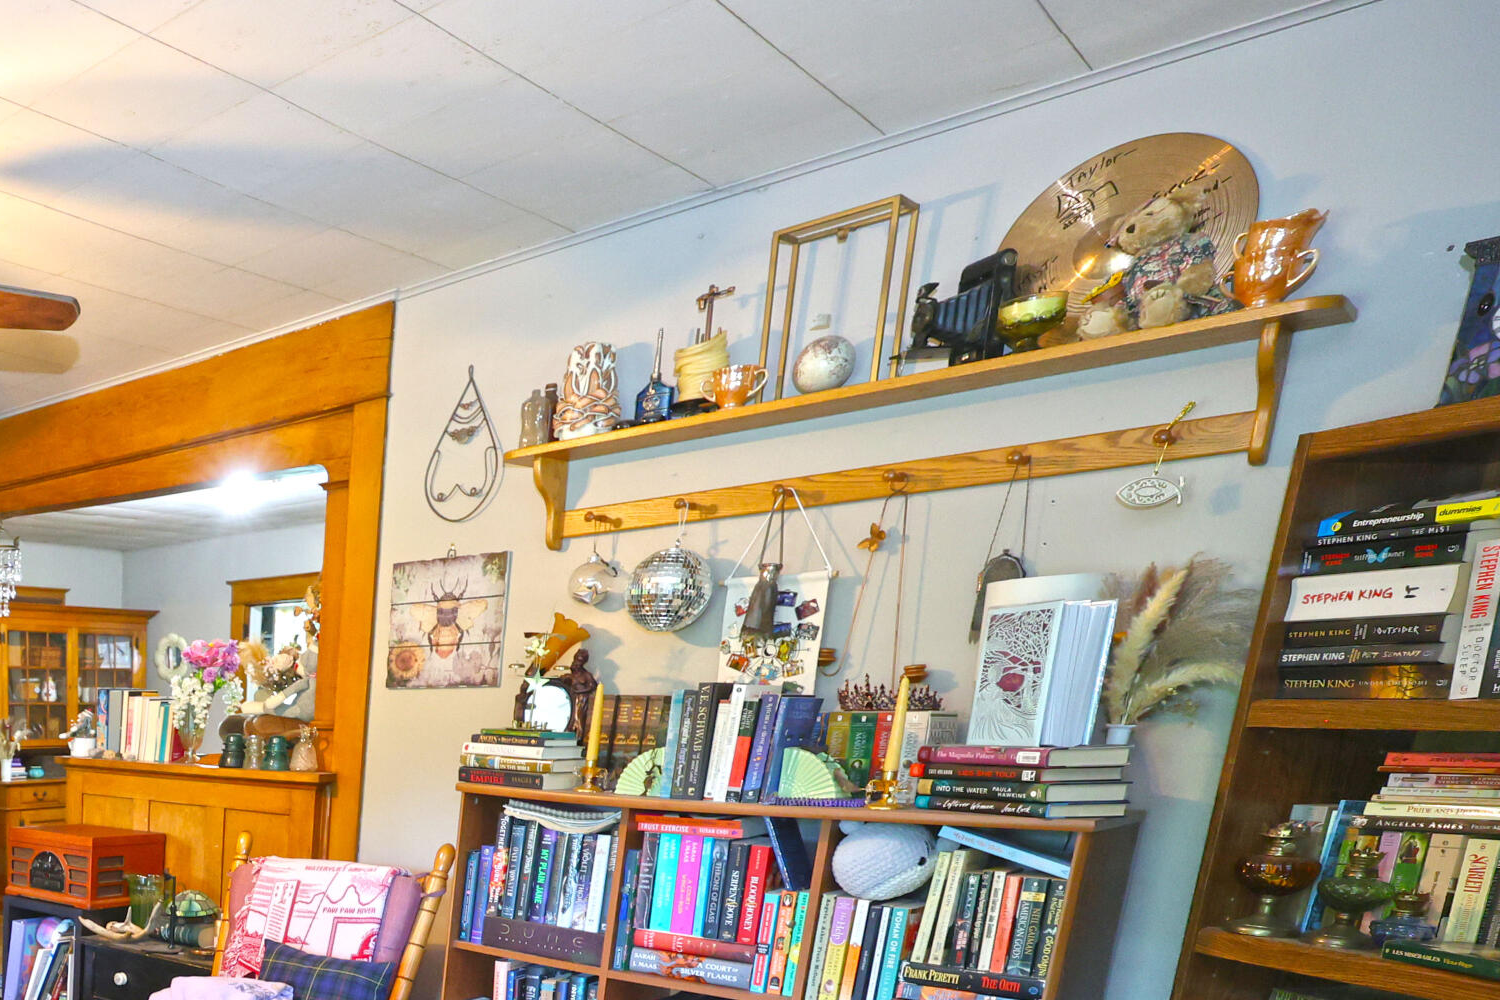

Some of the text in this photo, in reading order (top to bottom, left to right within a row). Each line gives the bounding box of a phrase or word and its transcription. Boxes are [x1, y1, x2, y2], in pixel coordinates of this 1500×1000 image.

[1352, 505, 1483, 527] Entrepreneurship dummies
[1317, 536, 1354, 546] STEPHEN
[1356, 533, 1378, 541] KING
[1474, 545, 1500, 591] STEPHEN
[1301, 588, 1394, 605] STEPHEN KING
[1469, 593, 1491, 620] KING
[1288, 630, 1326, 638] STEPHEN
[1282, 651, 1345, 662] STEPHEN KING
[1284, 678, 1355, 689] STEPHEN KING
[693, 706, 709, 753] SCHWAB
[470, 774, 505, 784] EMPIRE
[498, 815, 509, 849] TOGETHER
[661, 824, 689, 833] EXERCISE
[1375, 819, 1464, 830] ANGELA'S ASHES
[534, 849, 550, 905] MY PLAIN JANE
[712, 862, 722, 892] THRONE
[729, 870, 740, 902] SERPENT
[748, 876, 759, 901] BLOOD
[340, 907, 355, 915] PAW
[356, 907, 376, 915] RIVER
[708, 903, 717, 924] GLASS
[835, 921, 847, 940] Help
[1011, 901, 1031, 959] AMERICAN GODS
[886, 911, 904, 969] WOMAN ON FIRE
[680, 967, 737, 982] SILVER FLAMES
[705, 963, 733, 972] COURT
[903, 966, 960, 985] FRANK PERETTI
[981, 975, 998, 989] THE
